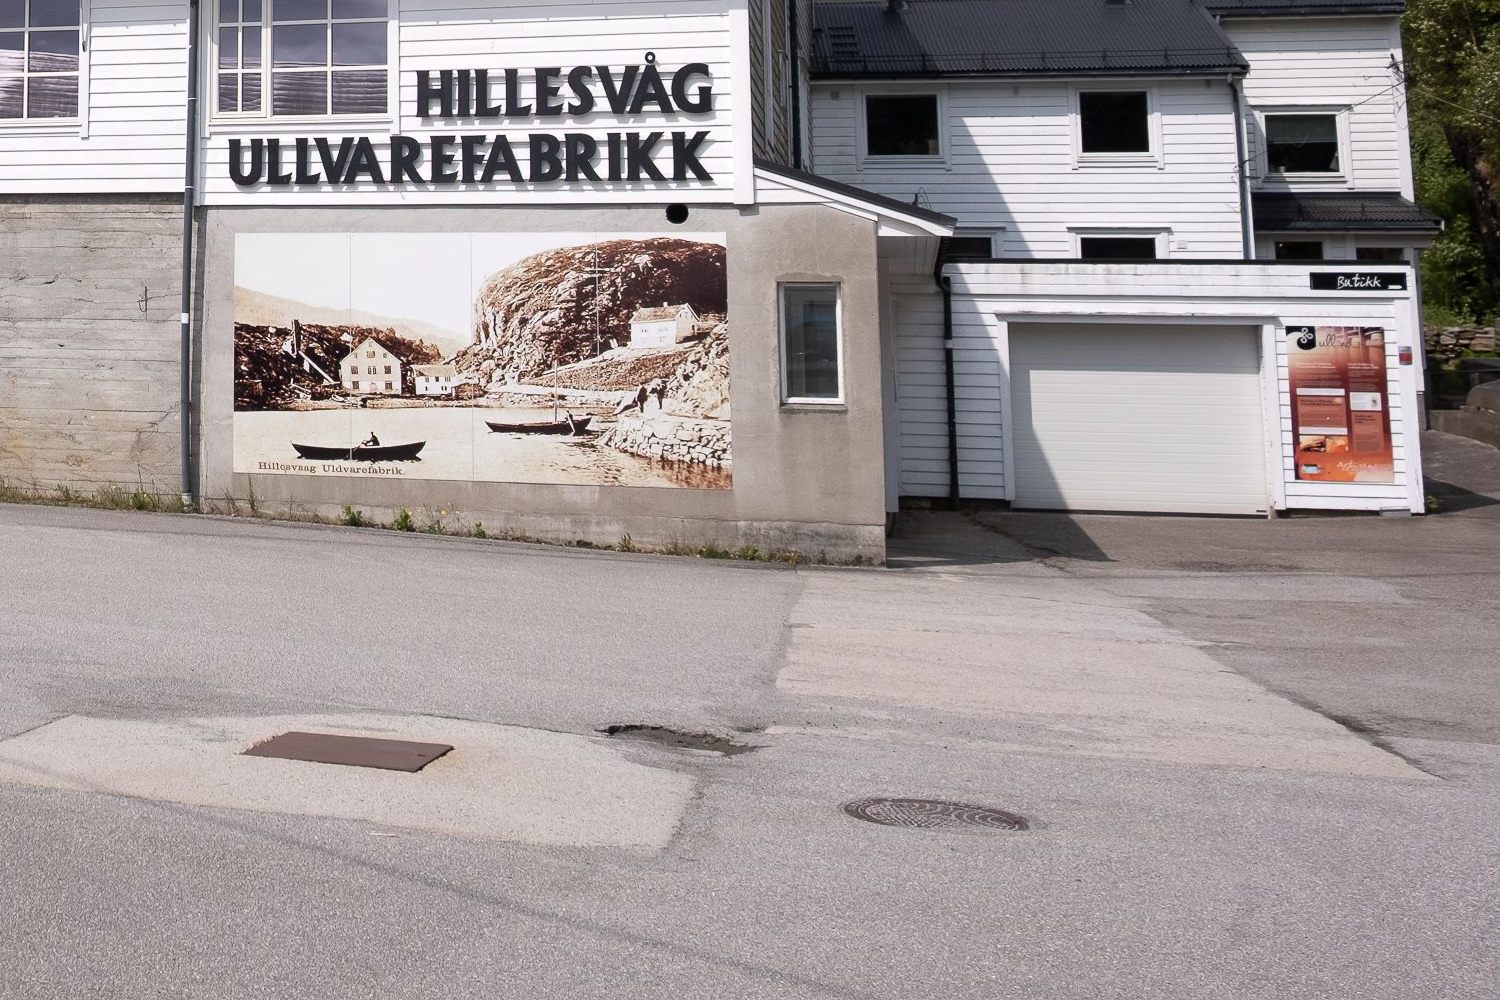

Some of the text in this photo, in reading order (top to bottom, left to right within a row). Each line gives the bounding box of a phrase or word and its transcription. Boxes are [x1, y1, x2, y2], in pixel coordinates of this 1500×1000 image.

[416, 51, 713, 118] HILLESVÅG
[228, 131, 714, 186] ULLVAREFABRIKK
[1336, 273, 1381, 290] Butikk
[258, 461, 317, 474] Hillesvaag
